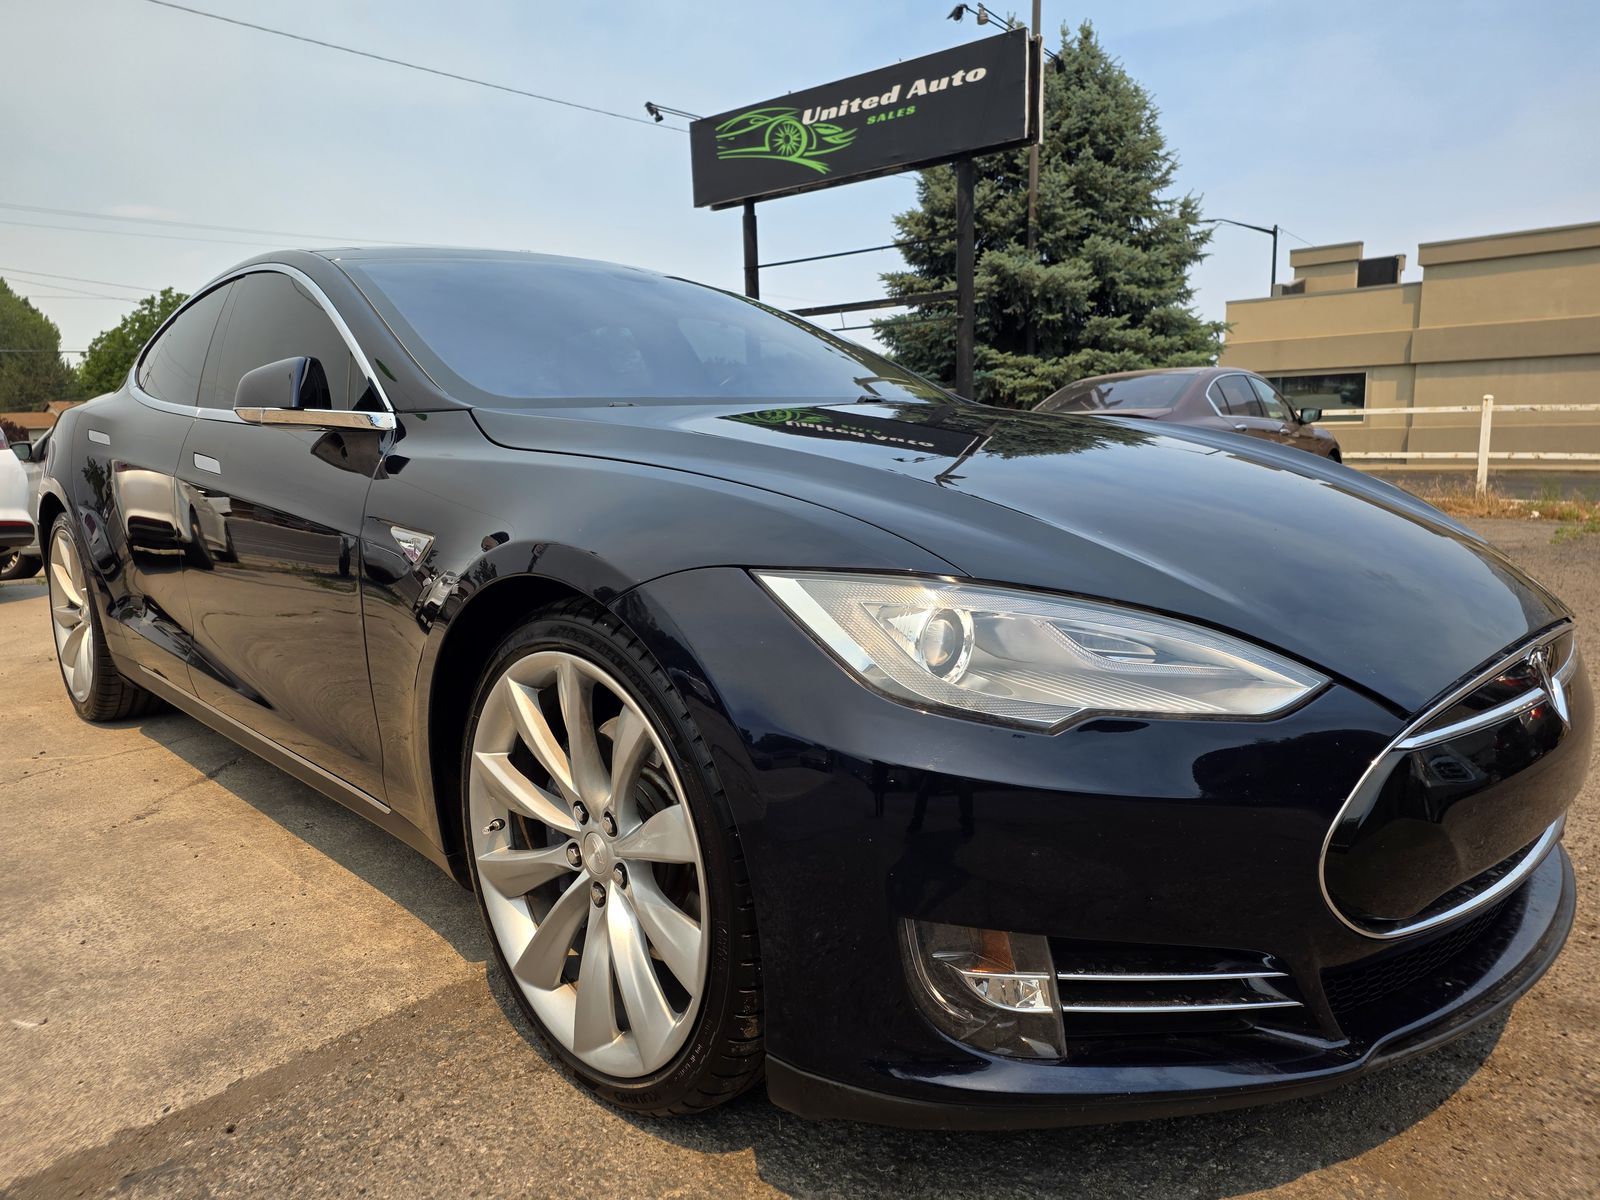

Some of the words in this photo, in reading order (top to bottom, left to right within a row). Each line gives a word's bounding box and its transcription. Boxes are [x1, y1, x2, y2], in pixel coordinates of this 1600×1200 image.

[802, 85, 902, 126] United
[906, 67, 986, 100] Auto
[867, 106, 917, 125] SALES
